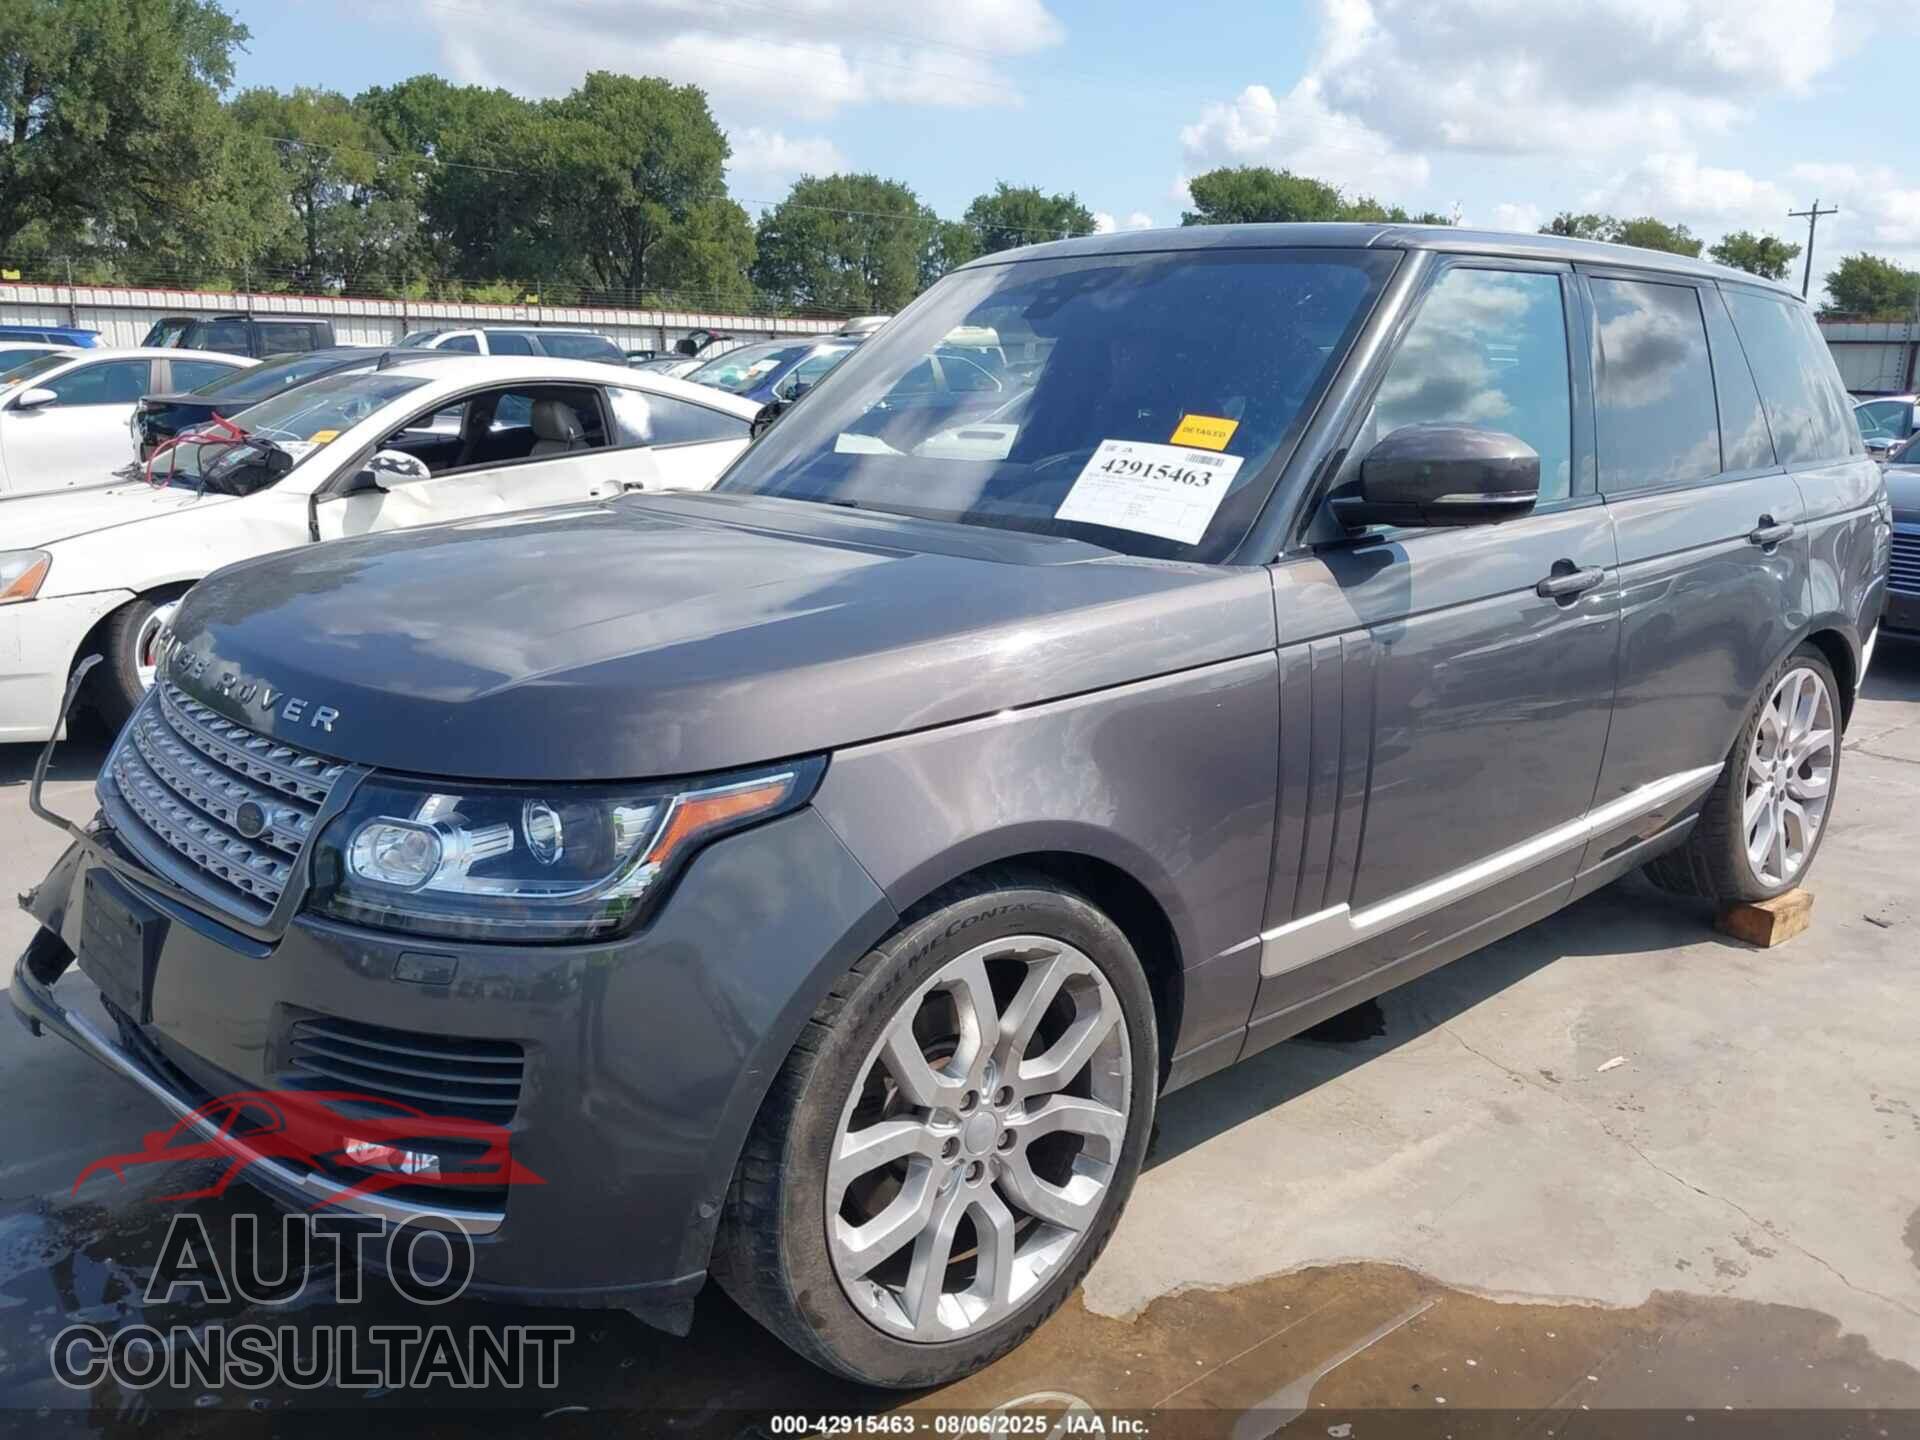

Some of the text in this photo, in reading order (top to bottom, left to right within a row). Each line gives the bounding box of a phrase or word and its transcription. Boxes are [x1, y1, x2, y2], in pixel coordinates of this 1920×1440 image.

[1182, 426, 1227, 438] DETAILED
[1100, 458, 1213, 488] 42915463
[215, 671, 340, 733] ROVER
